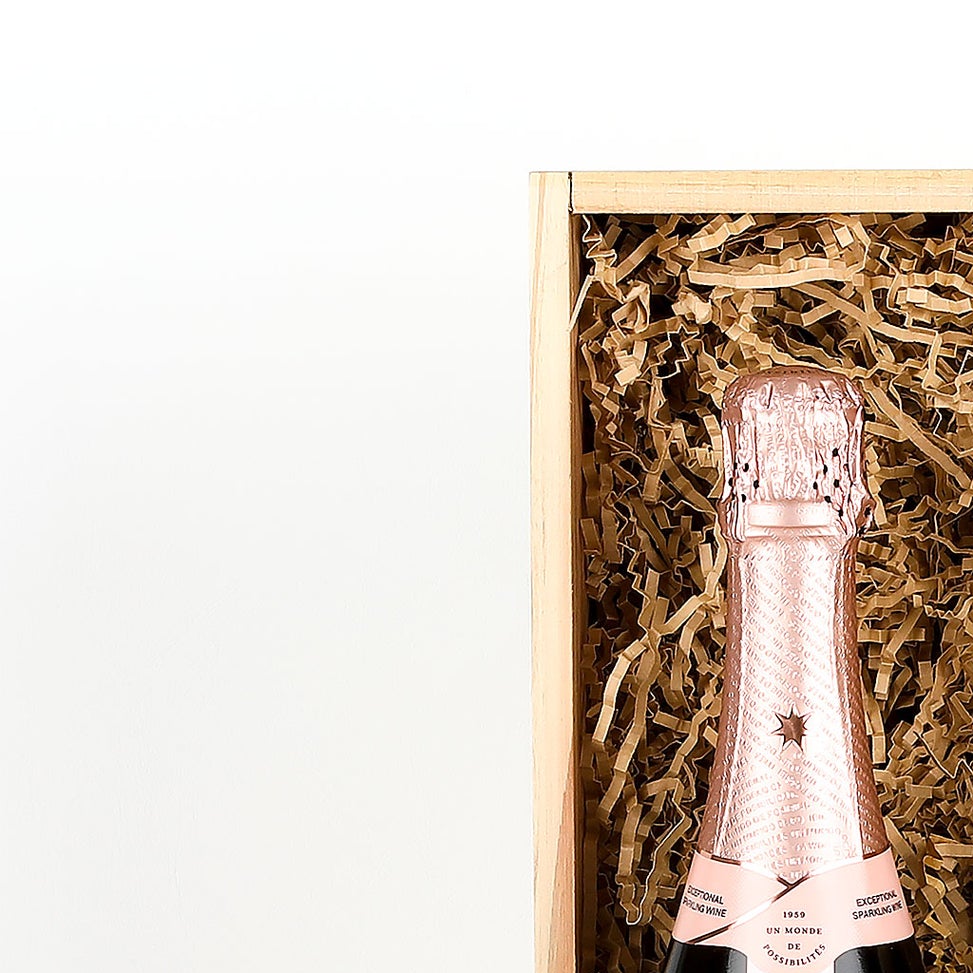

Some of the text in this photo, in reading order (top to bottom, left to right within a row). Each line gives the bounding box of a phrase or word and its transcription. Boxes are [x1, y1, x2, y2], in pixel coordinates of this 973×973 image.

[705, 905, 728, 918] WINE
[783, 911, 806, 919] 1959
[766, 927, 823, 935] UN MONDE
[787, 943, 801, 951] DE
